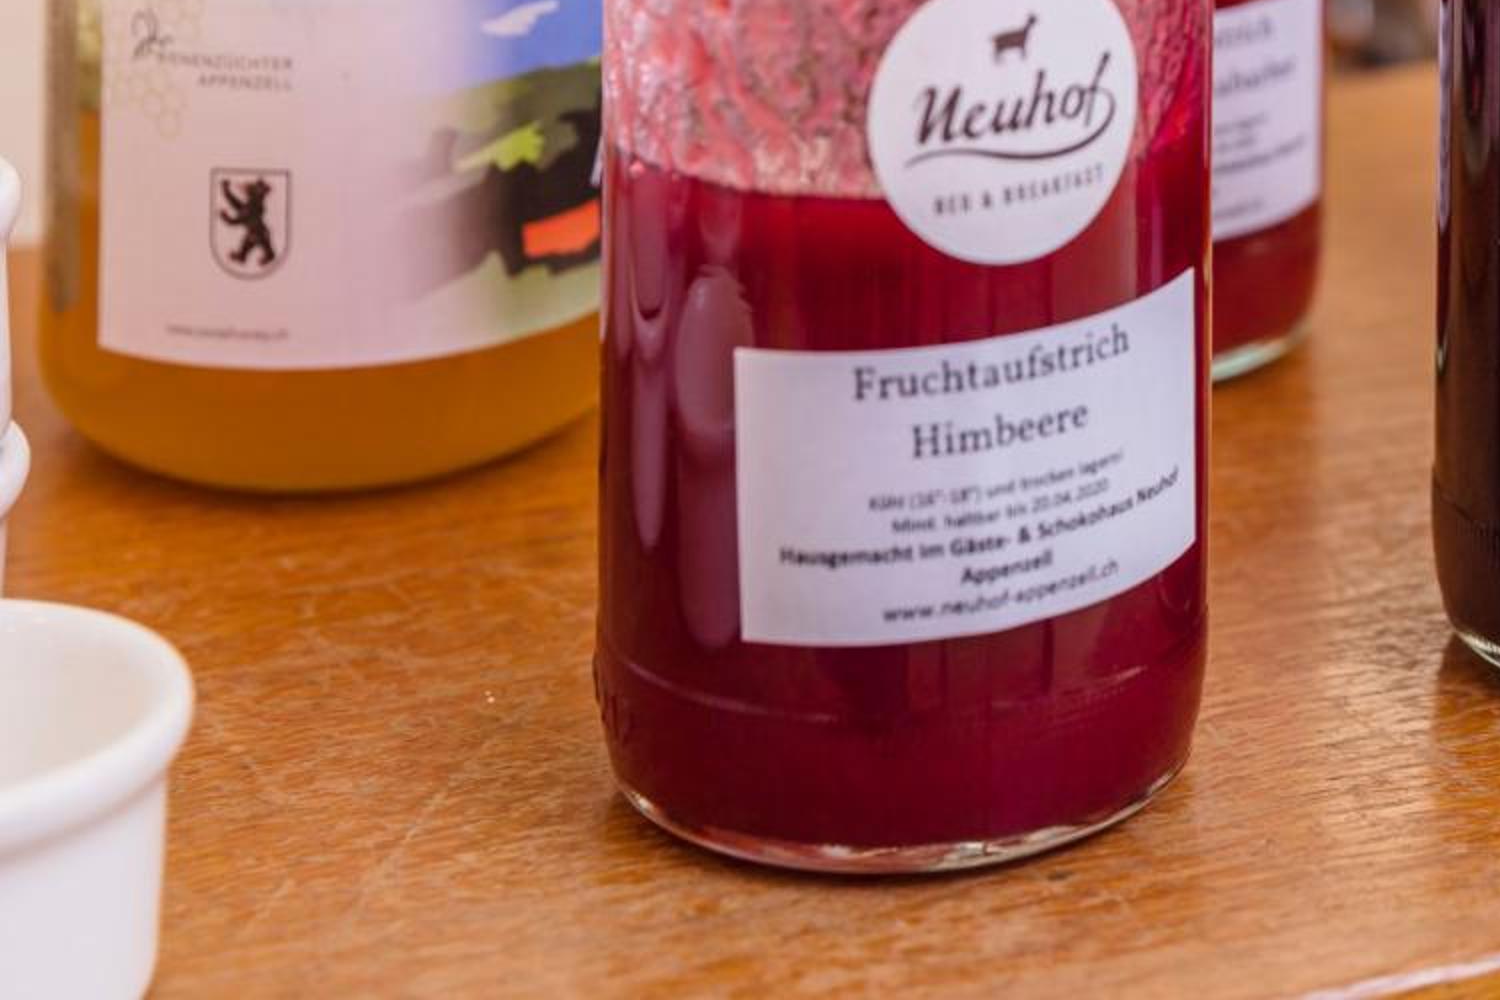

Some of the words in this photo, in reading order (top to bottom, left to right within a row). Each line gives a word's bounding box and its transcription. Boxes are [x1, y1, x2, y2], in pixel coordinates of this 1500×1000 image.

[912, 51, 1116, 145] Neuhof
[934, 194, 970, 216] BED
[981, 192, 993, 209] &
[1003, 163, 1104, 206] BREAKFAST
[853, 323, 1130, 401] Fruchtaufstrich
[912, 404, 1089, 459] Himbeere
[986, 479, 1015, 498] und
[1019, 466, 1075, 491] trocken
[780, 546, 913, 569] Hausgemacht
[919, 543, 944, 560] im
[950, 535, 1012, 556] Gäste-
[1018, 525, 1031, 545] &
[1037, 496, 1134, 539] Schokohaus
[1136, 464, 1180, 502] Neuhof
[944, 509, 1000, 530] haltbar
[1006, 504, 1028, 520] bis
[883, 560, 1120, 623] www.neuhof-appenzell.ch
[961, 549, 1052, 586] Appenzell
